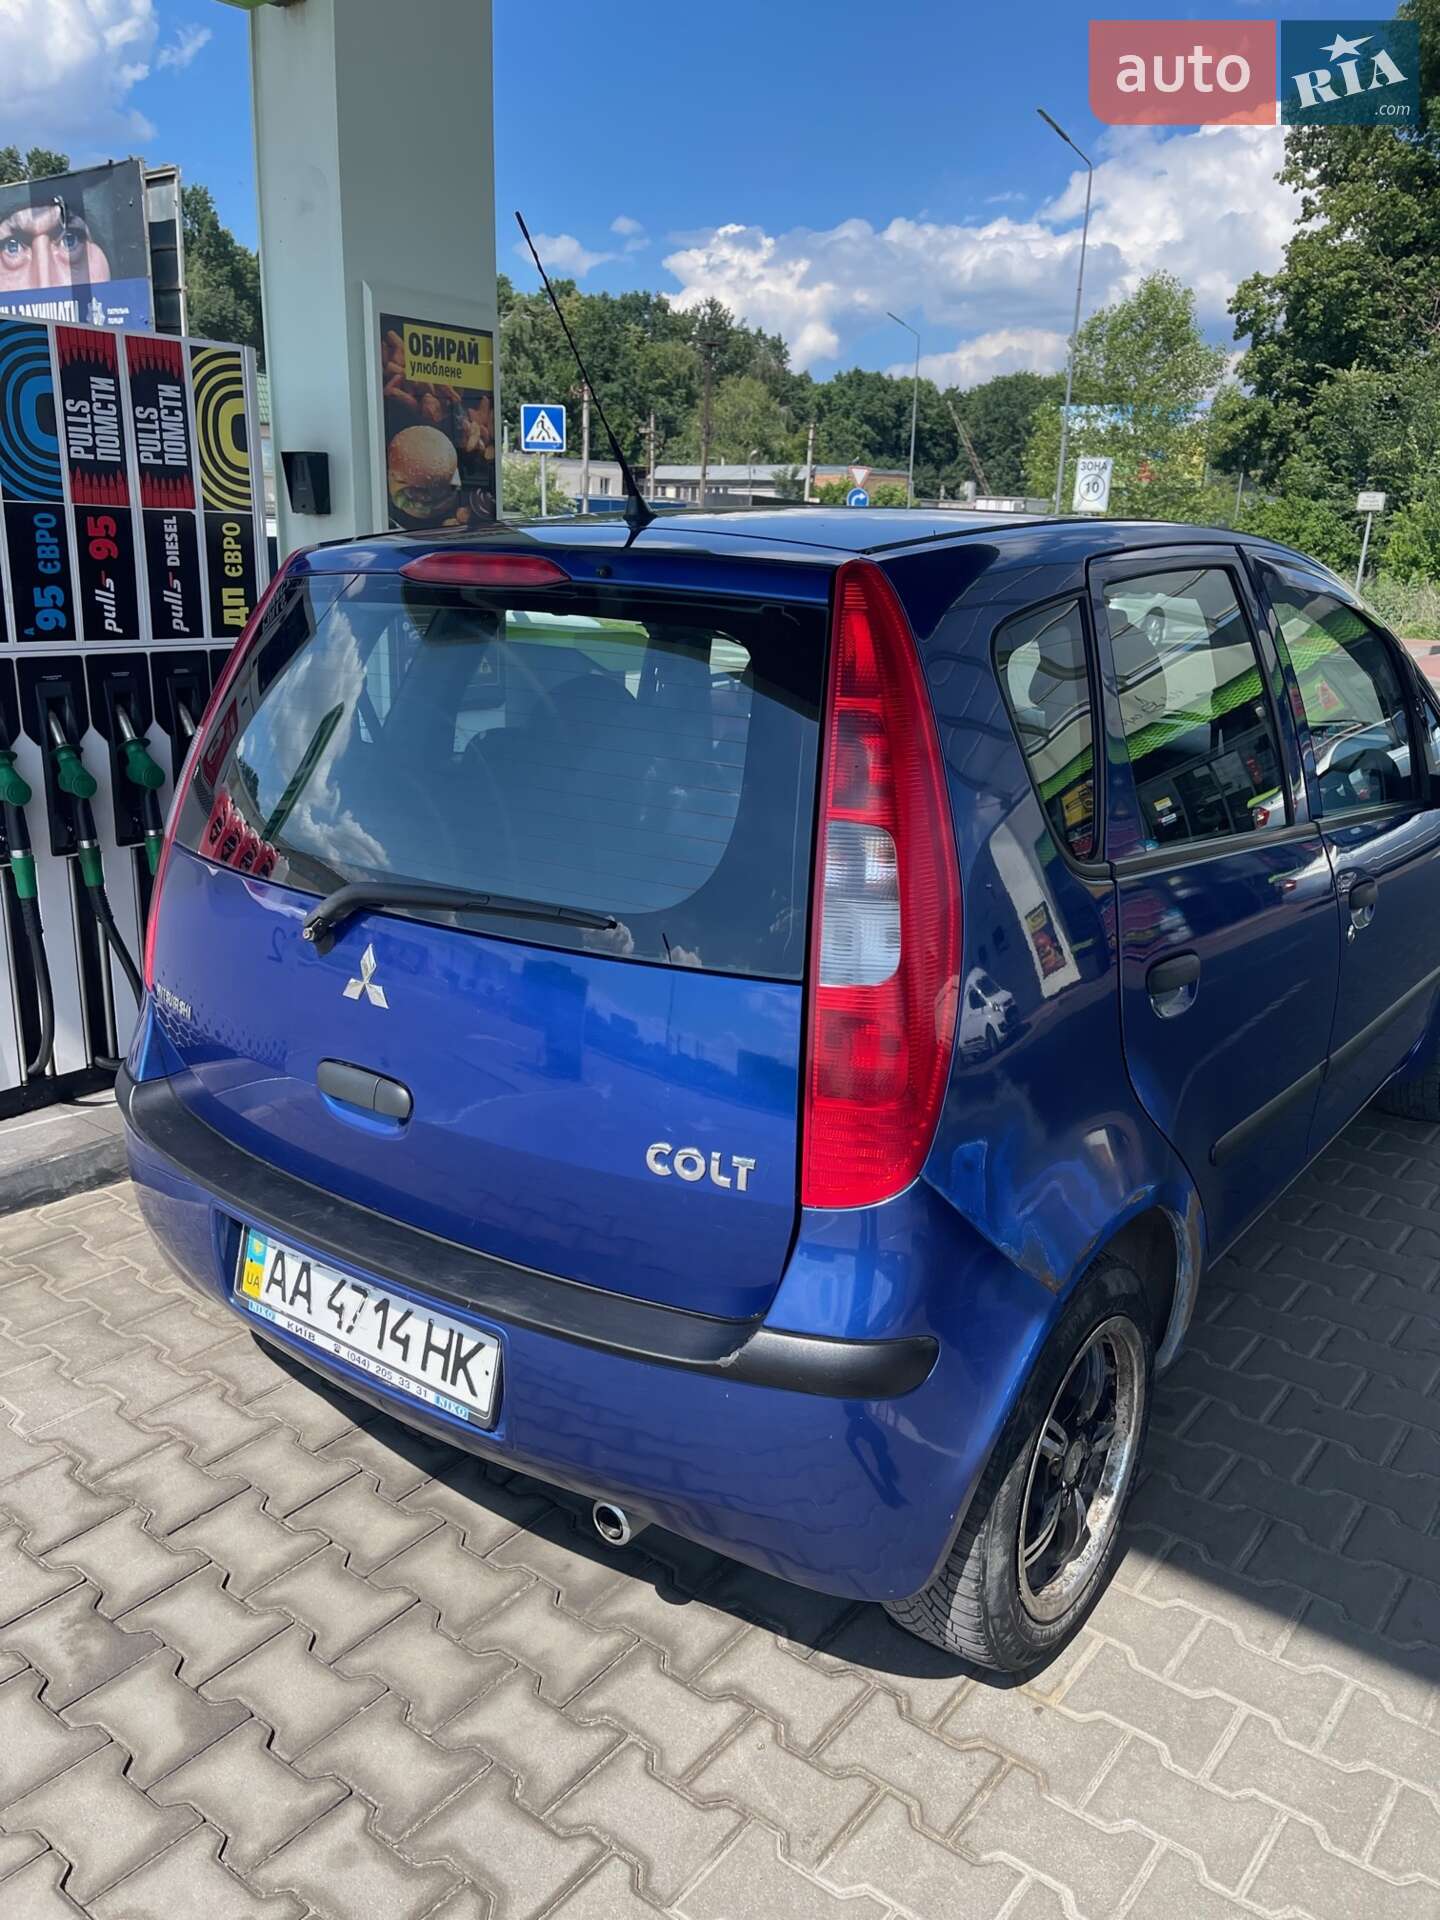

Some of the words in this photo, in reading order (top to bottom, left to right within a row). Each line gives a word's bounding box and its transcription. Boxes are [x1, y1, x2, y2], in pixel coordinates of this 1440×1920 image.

[408, 332, 480, 365] ОБИРАЙ
[410, 360, 462, 380] улюблене
[65, 399, 95, 461] PULLS
[90, 376, 121, 462] ПОМСТИ
[135, 406, 163, 466] PULLS
[158, 384, 188, 466] ПОМСТИ
[1080, 461, 1108, 472] ЗОНА
[1085, 481, 1100, 494] 10
[33, 512, 61, 575] ЄВРО
[87, 515, 118, 560] 95
[163, 515, 181, 567] DIESEL
[221, 521, 243, 578] ЄВРО
[33, 585, 67, 631] 95
[95, 573, 124, 634] pulls
[163, 574, 190, 633] pulls
[221, 588, 250, 628] ДП
[646, 1142, 756, 1191] COLT
[246, 1269, 261, 1289] UA
[327, 1279, 414, 1362] 4714
[346, 1350, 371, 1370] (044)
[375, 1364, 394, 1381] 205
[398, 1376, 411, 1390] 33
[415, 1385, 429, 1398] 31
